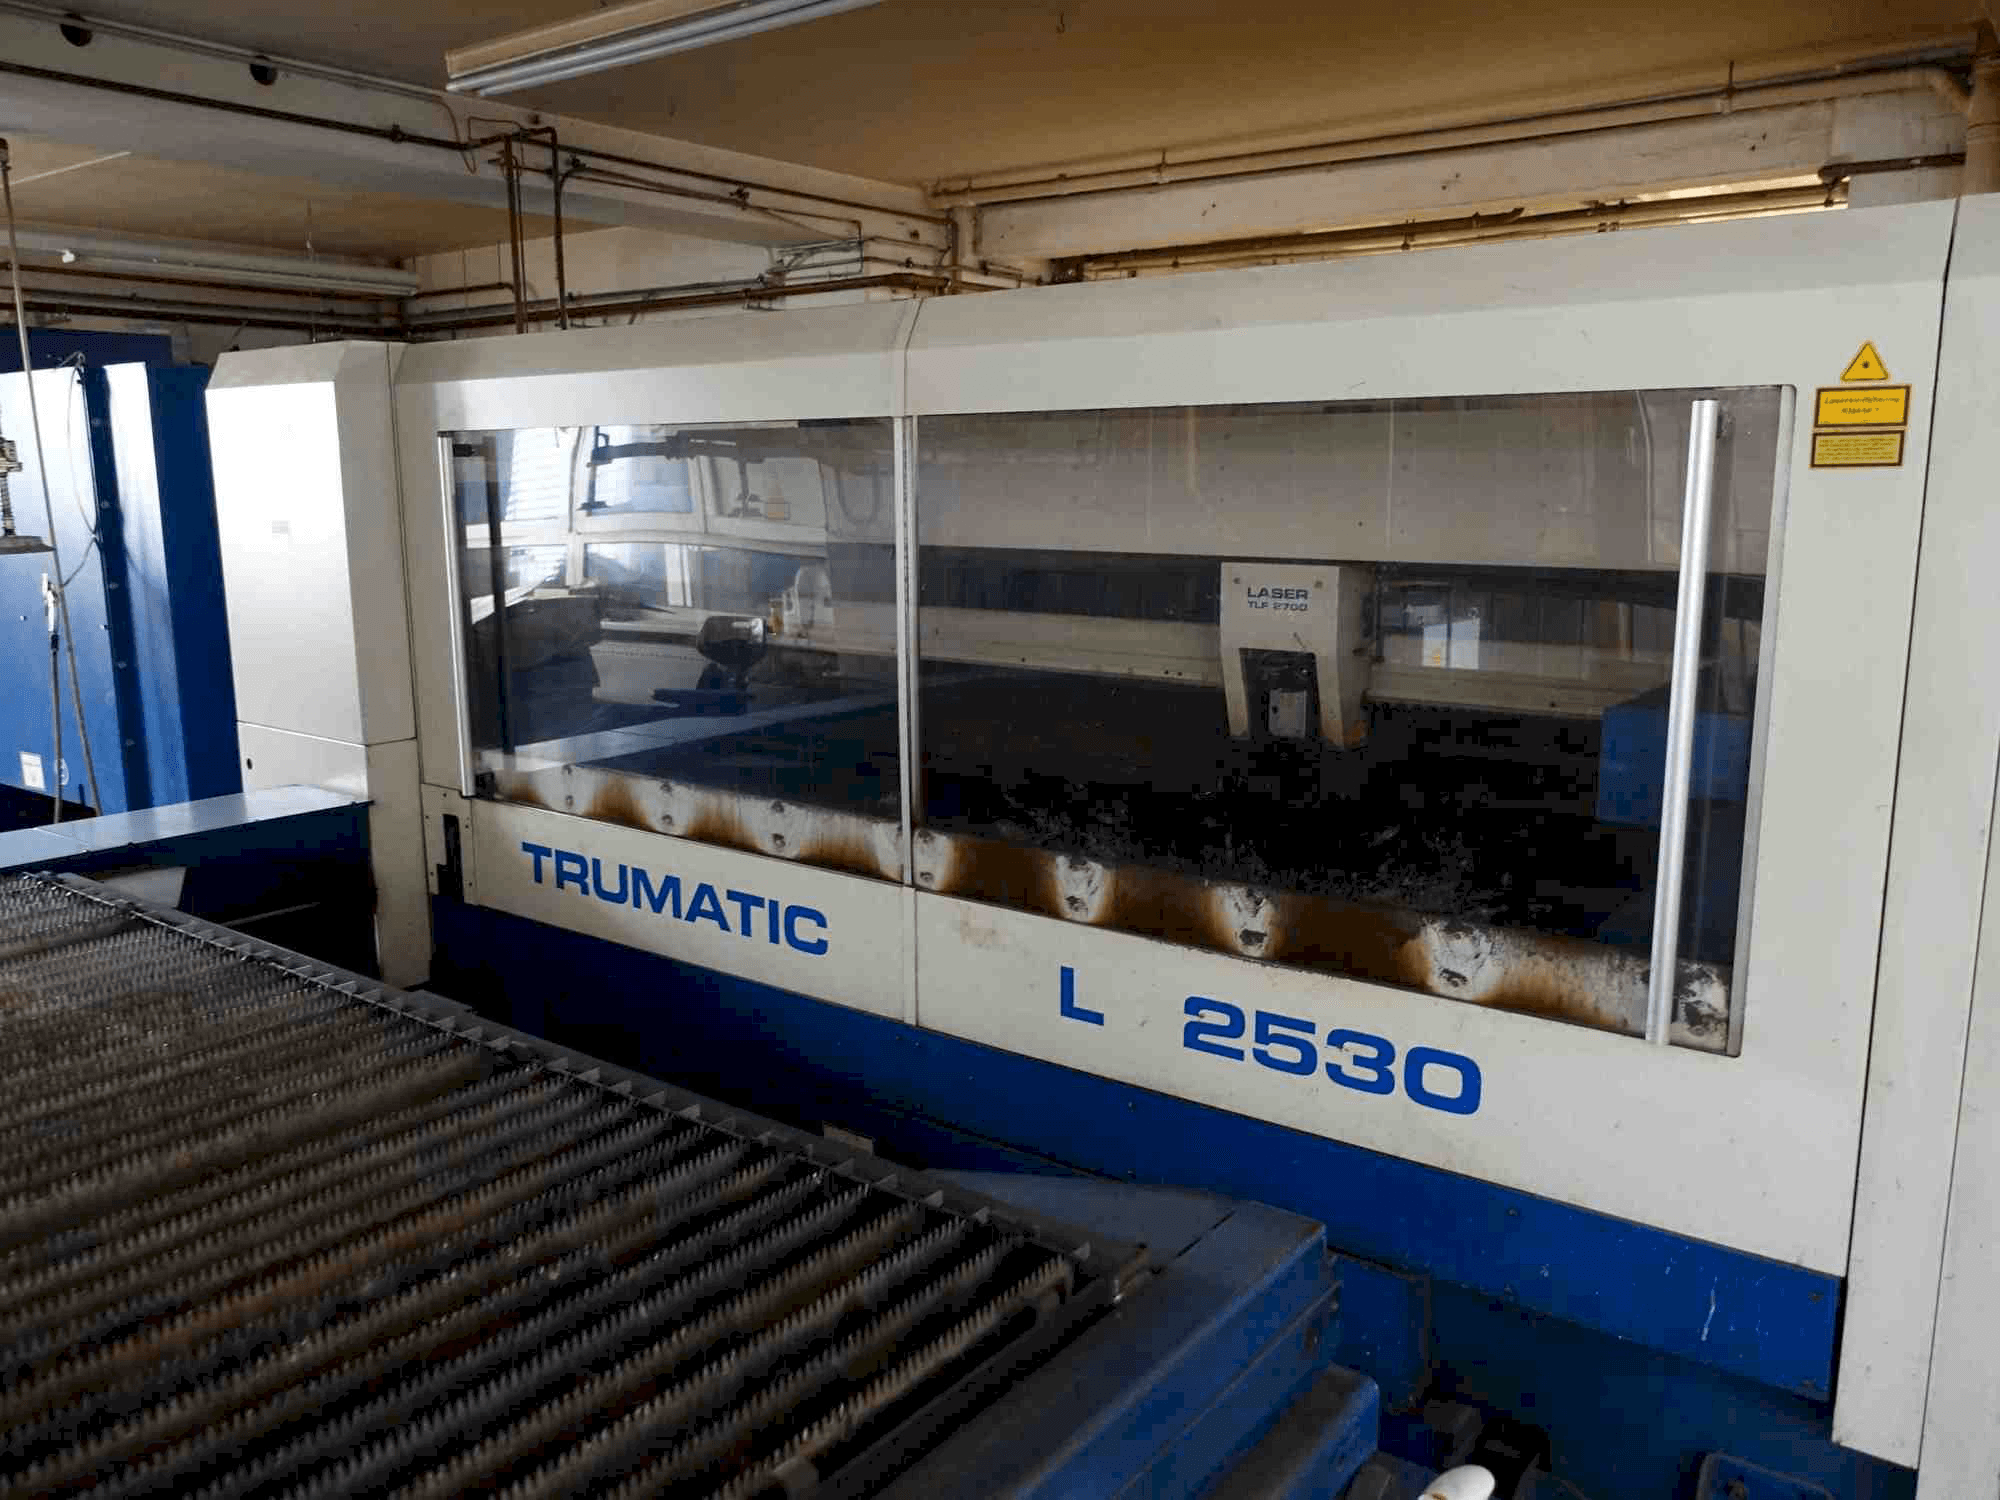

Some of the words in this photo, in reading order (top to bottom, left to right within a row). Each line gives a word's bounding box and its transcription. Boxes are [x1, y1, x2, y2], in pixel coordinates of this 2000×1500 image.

[1247, 587, 1308, 600] LASER
[1247, 600, 1269, 609] TLF
[1272, 602, 1308, 611] 2700
[521, 841, 829, 956] TRUMATIC
[1060, 965, 1105, 1027] L
[1183, 996, 1482, 1116] 2530
